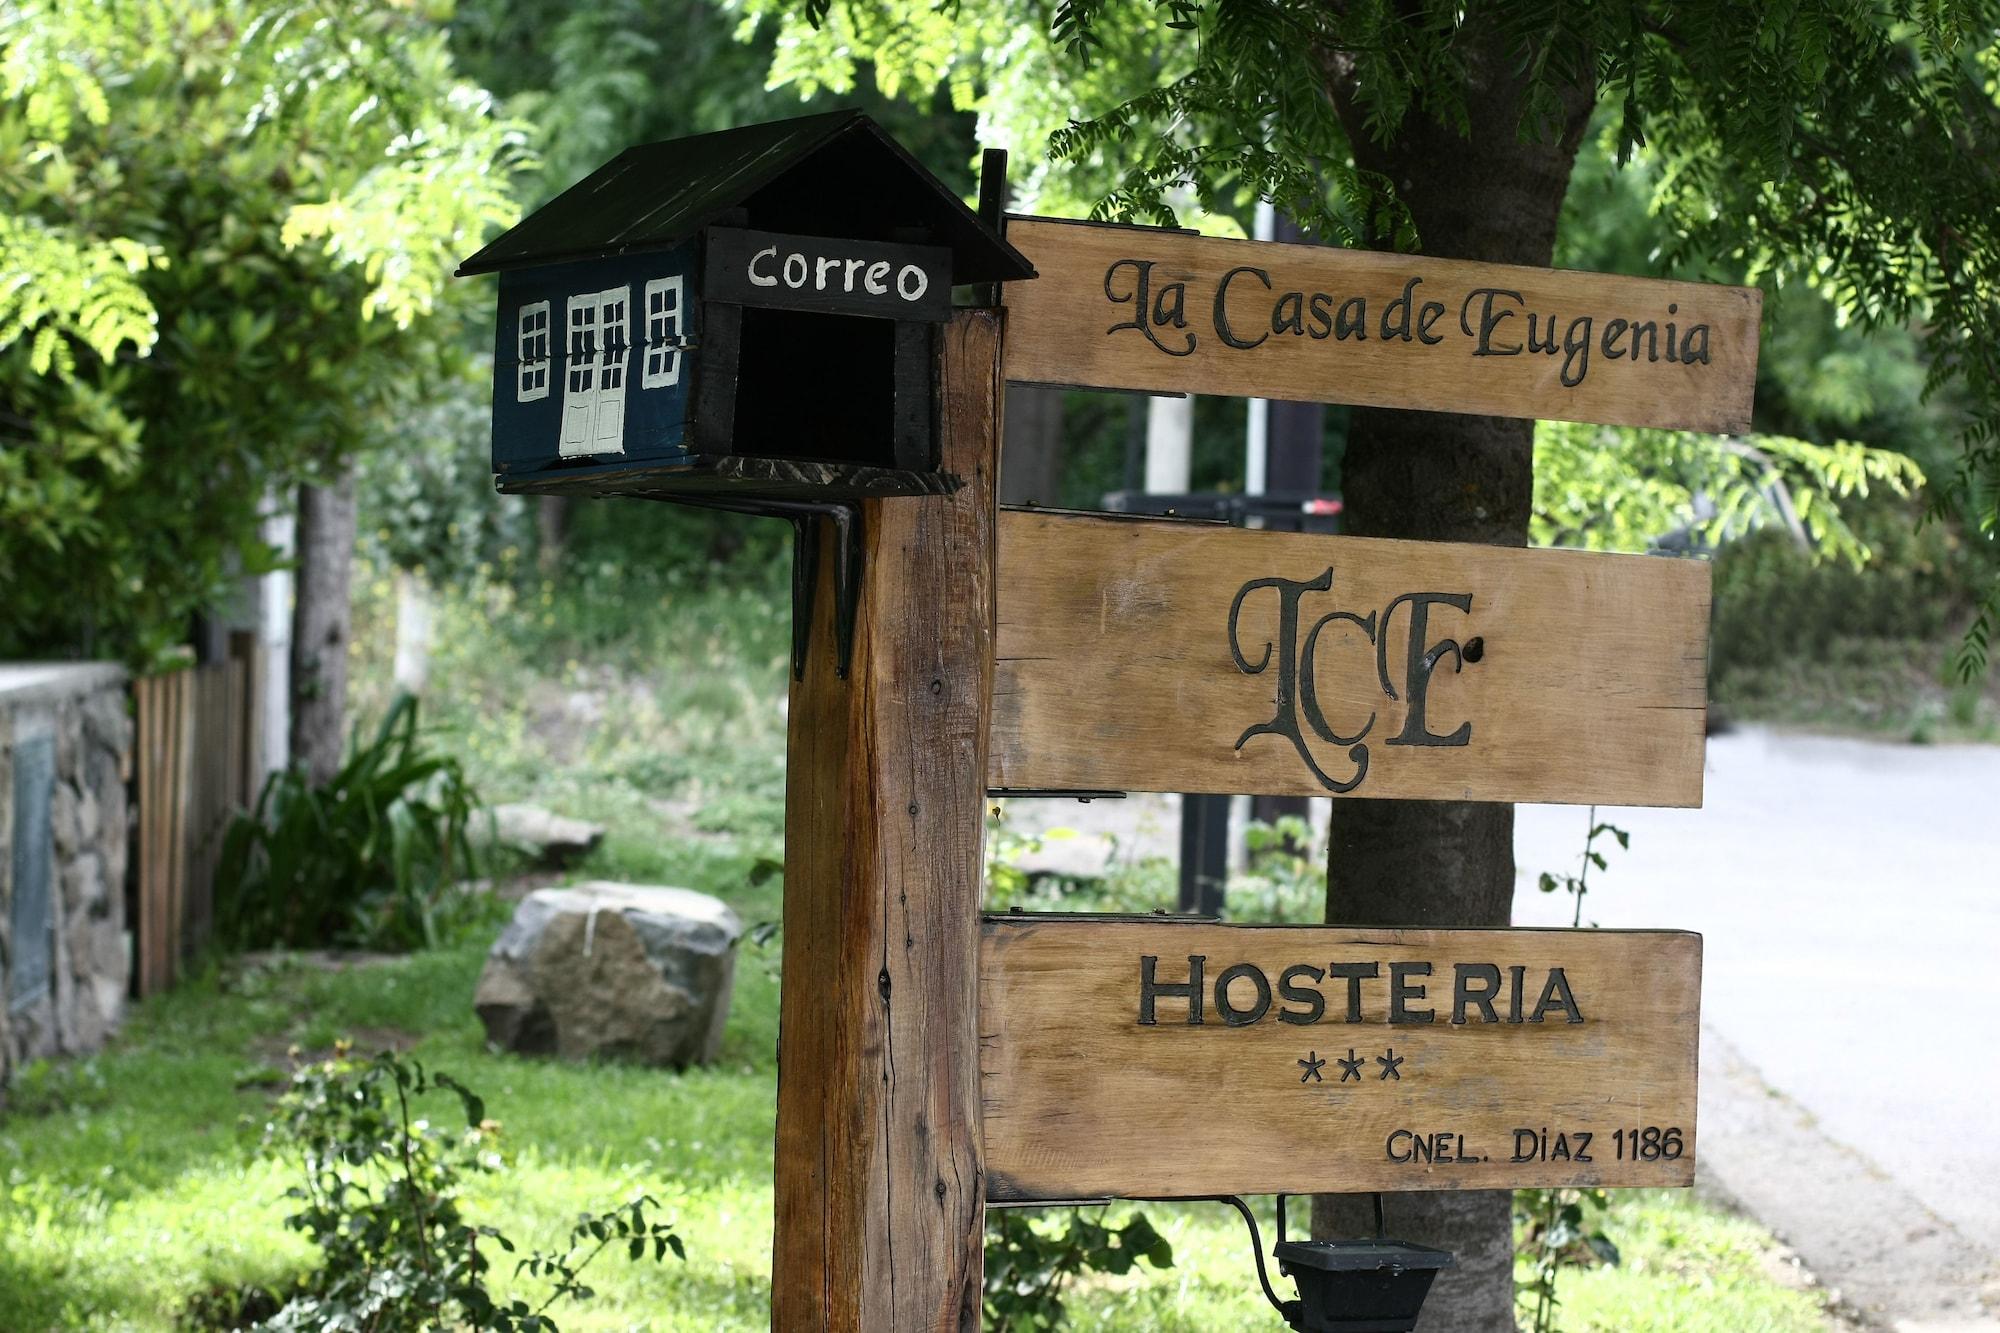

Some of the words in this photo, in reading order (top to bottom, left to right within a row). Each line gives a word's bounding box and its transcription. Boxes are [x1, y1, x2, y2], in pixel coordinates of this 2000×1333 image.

[1104, 259, 1196, 356] La
[1213, 266, 1367, 350] Casa
[1380, 277, 1446, 345] de
[1460, 287, 1711, 388] Eugenia
[1137, 955, 1584, 1026] HOSTERIA
[1386, 1129, 1488, 1163] CNEL.
[1613, 1126, 1684, 1161] 1186
